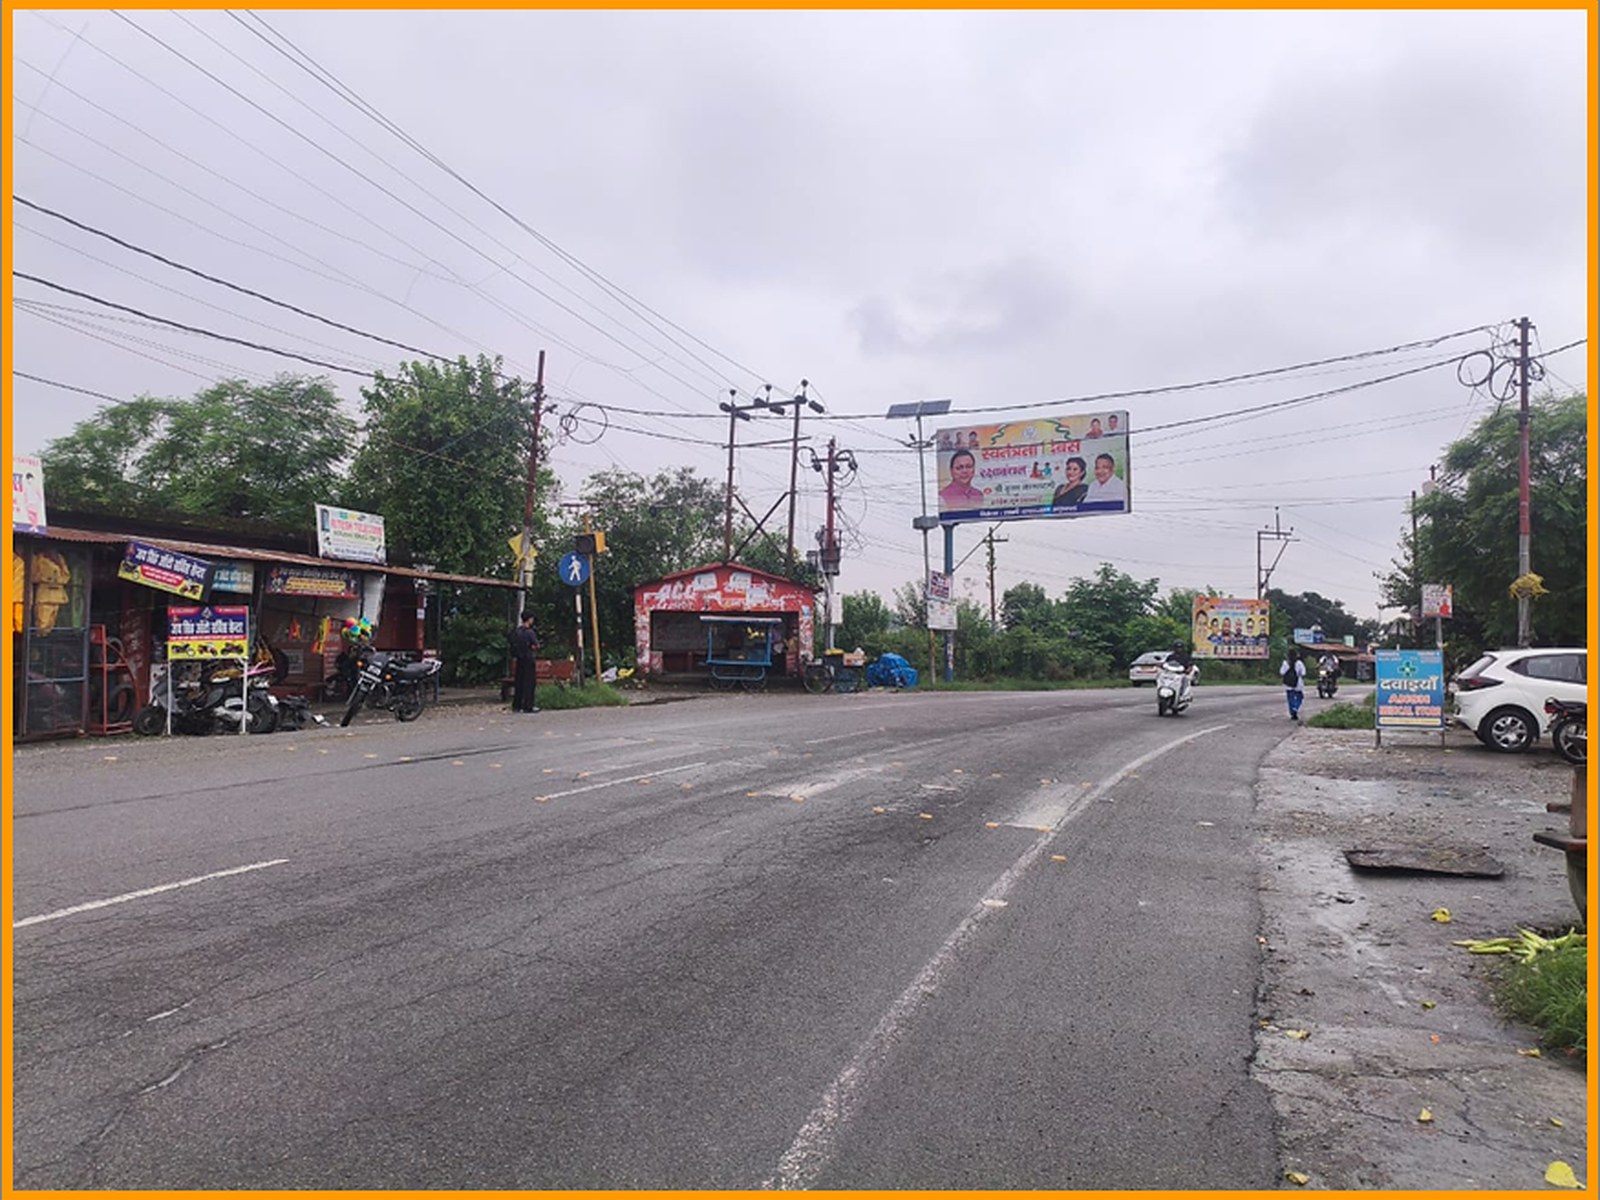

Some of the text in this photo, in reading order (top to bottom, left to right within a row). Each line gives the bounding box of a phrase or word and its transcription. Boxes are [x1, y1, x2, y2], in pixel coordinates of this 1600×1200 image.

[981, 439, 1080, 460] स्वतंत्रता दिवस
[1380, 674, 1440, 692] दवाइयाँ
